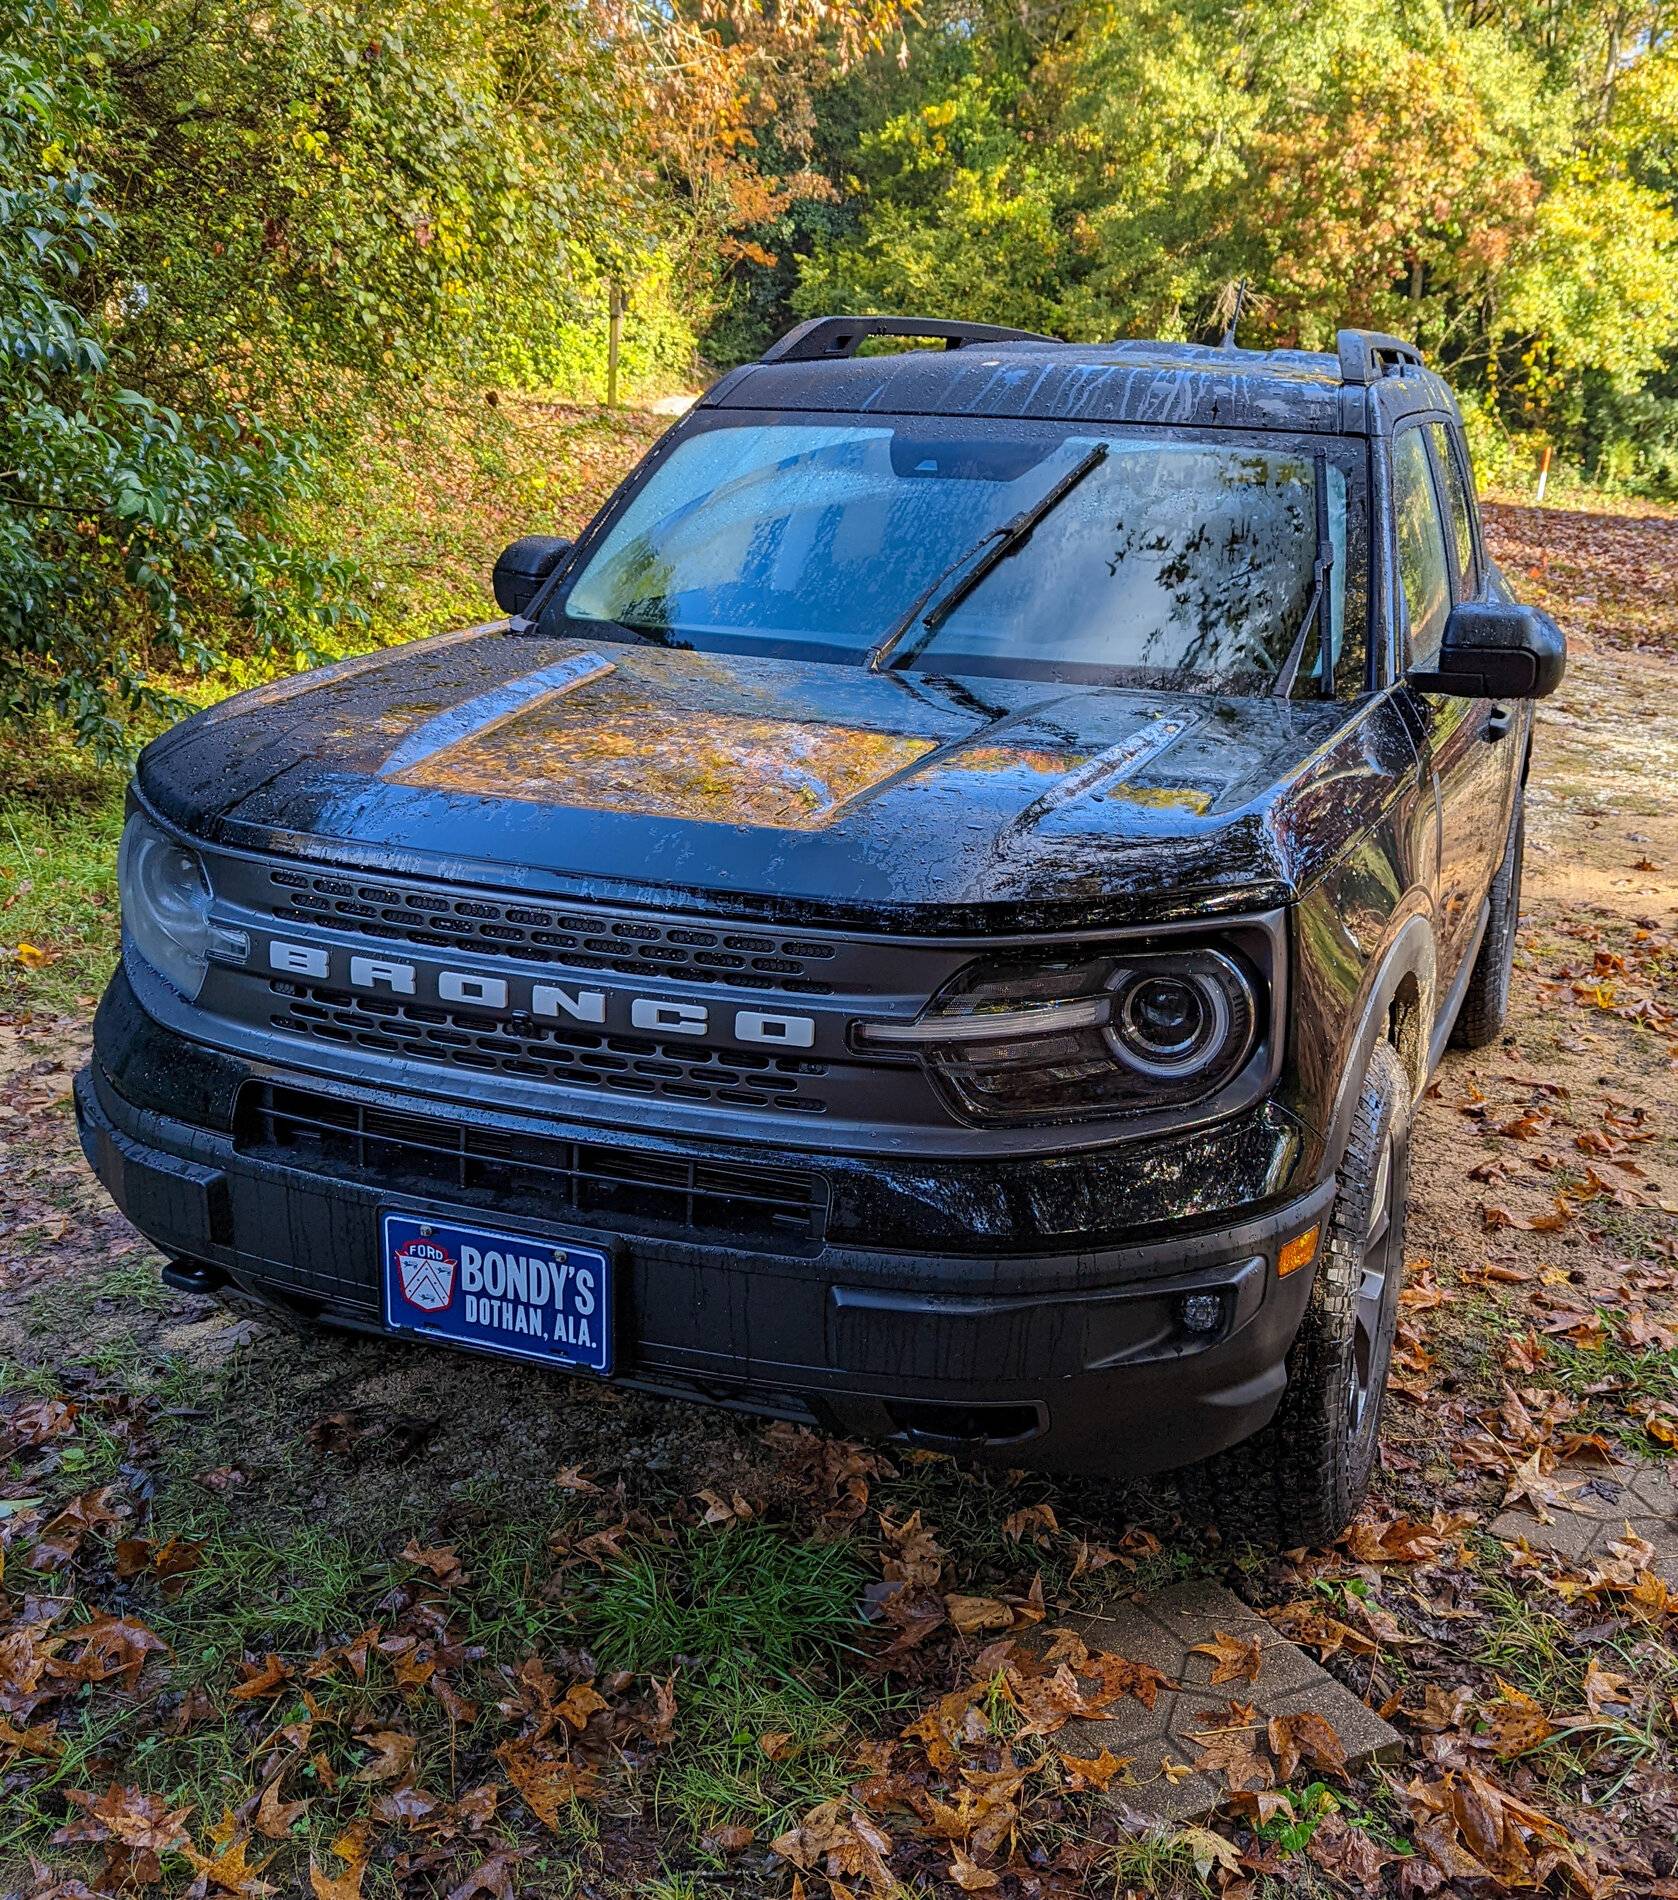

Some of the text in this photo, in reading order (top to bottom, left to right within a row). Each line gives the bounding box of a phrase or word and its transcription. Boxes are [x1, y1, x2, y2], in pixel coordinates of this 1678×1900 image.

[269, 940, 815, 1047] BRONCO
[409, 1245, 443, 1261] FORD
[460, 1245, 595, 1315] BONDY'S
[465, 1295, 597, 1348] DOTHAN, ALA.
